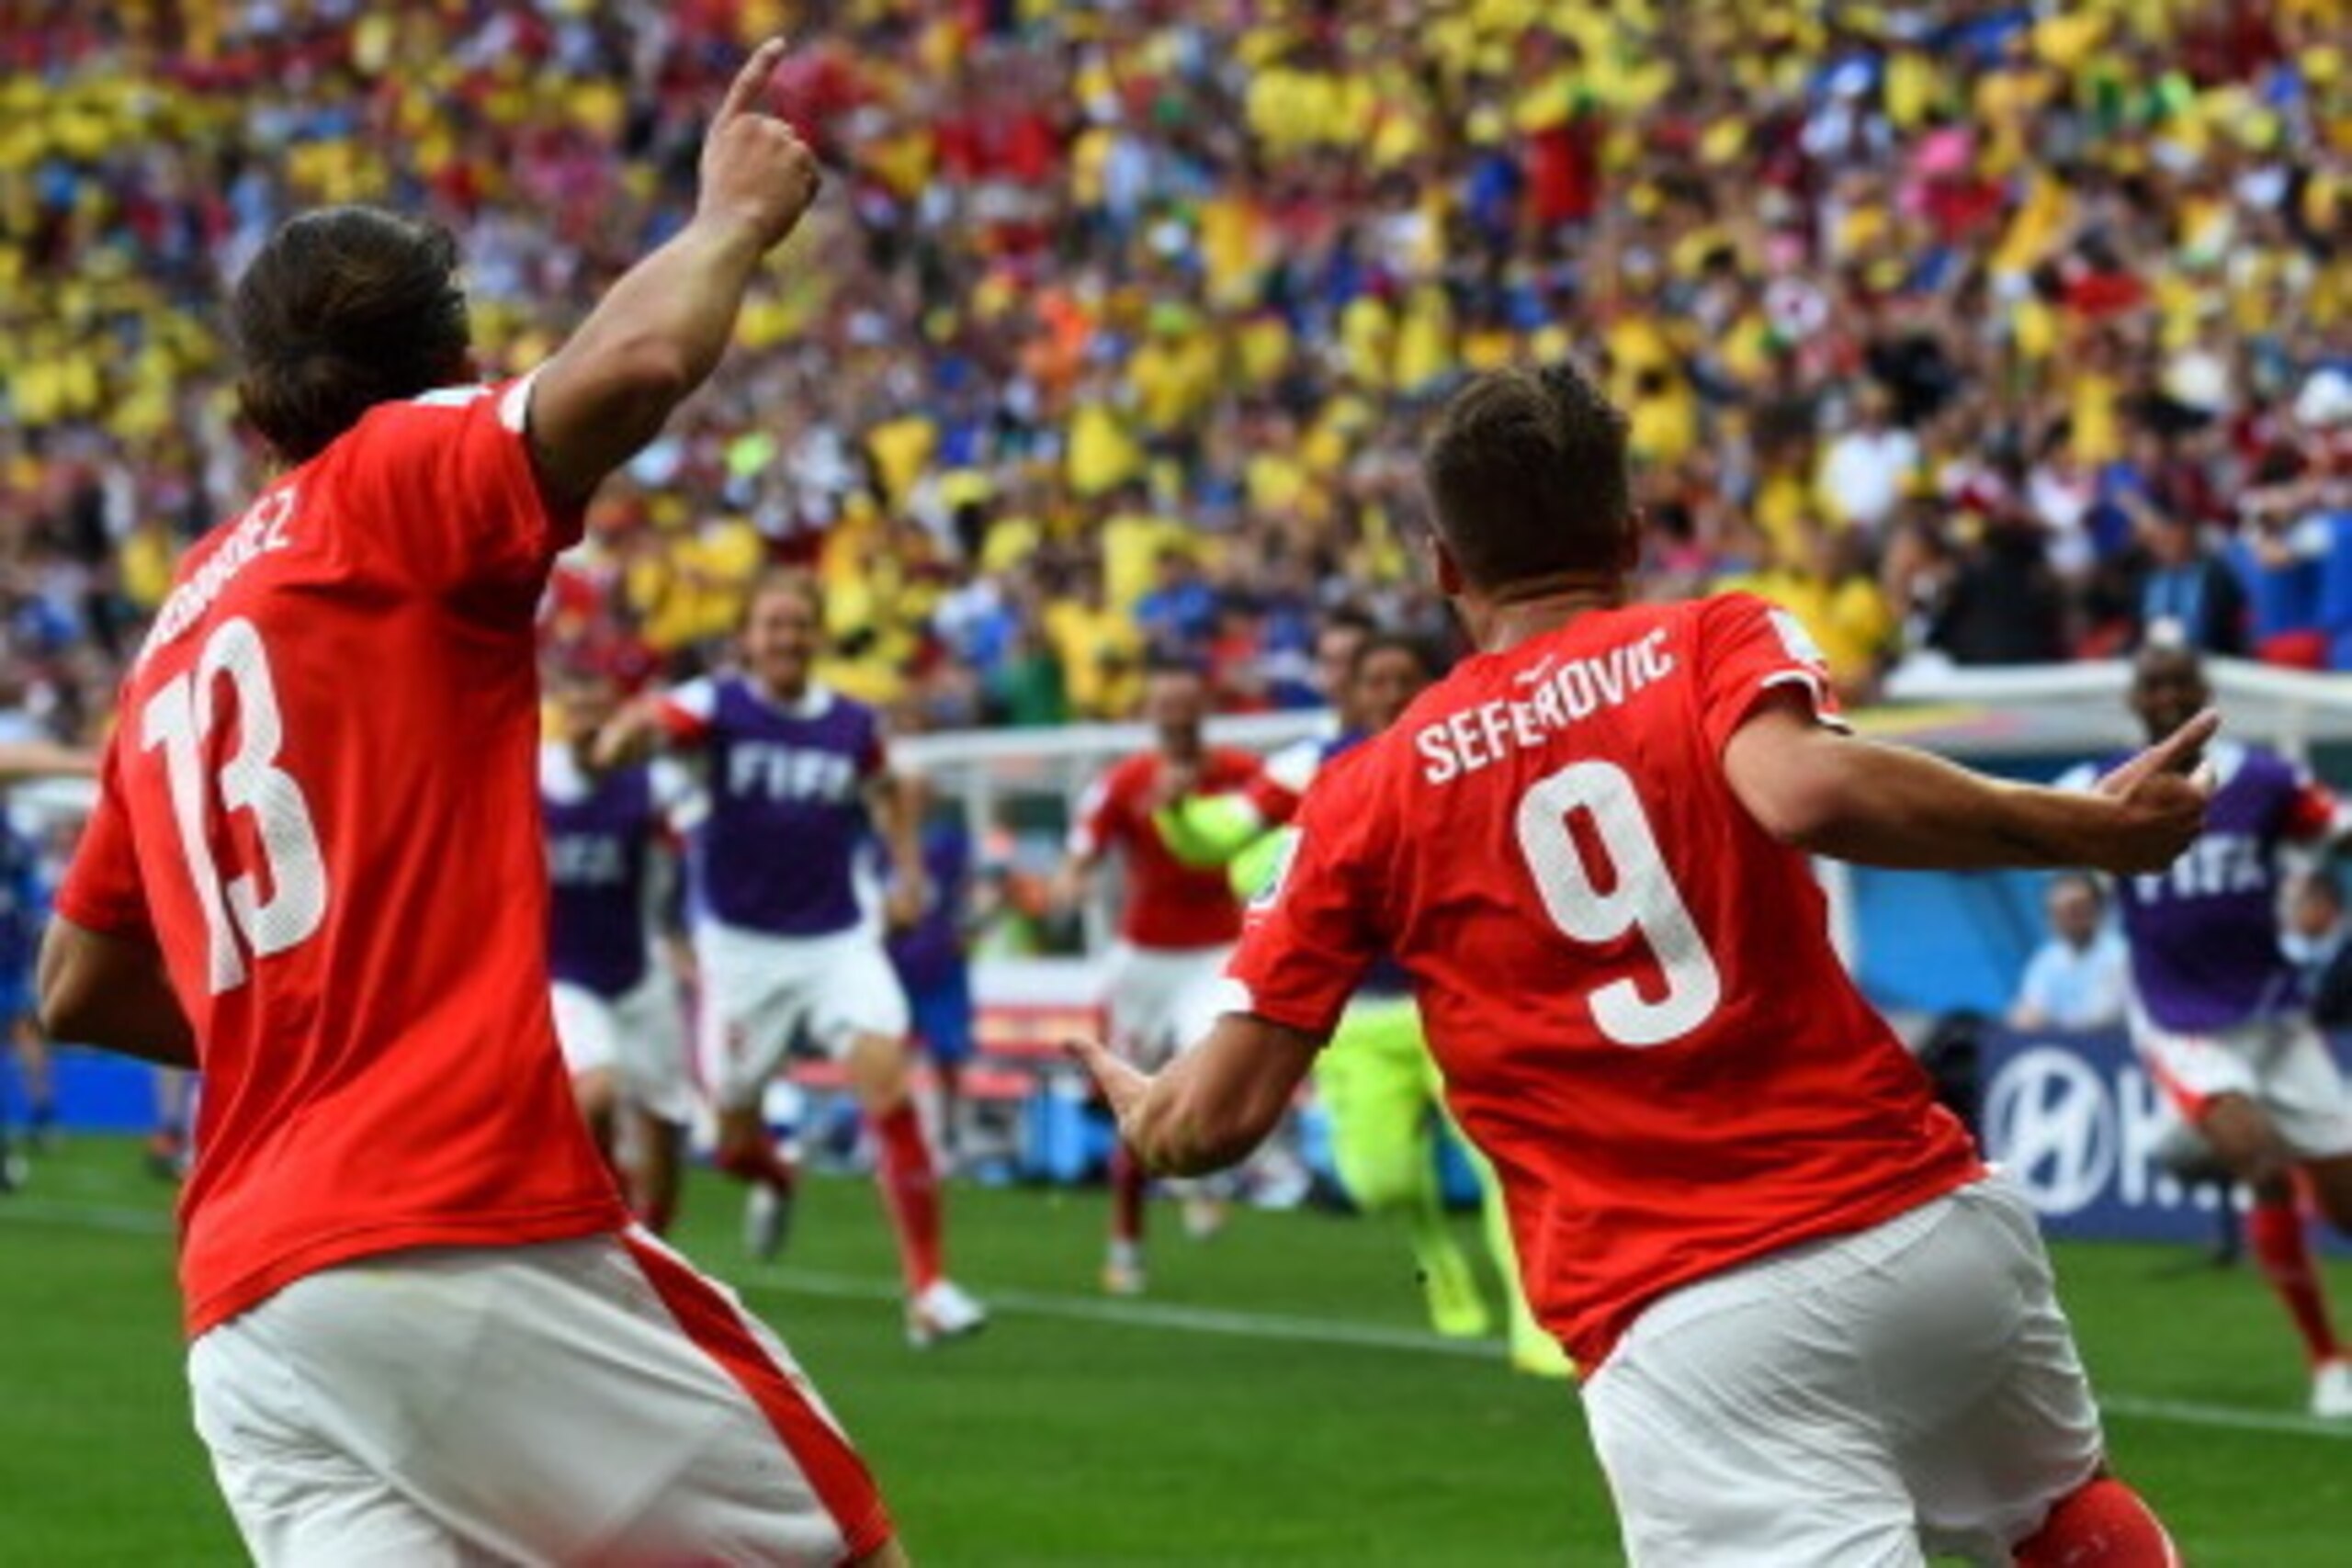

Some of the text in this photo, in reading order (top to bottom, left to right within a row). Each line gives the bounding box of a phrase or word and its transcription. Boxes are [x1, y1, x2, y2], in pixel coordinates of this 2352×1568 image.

[141, 614, 328, 997] 13
[1416, 627, 1674, 784] SEFEROVIC
[1516, 759, 1721, 1045] 9
